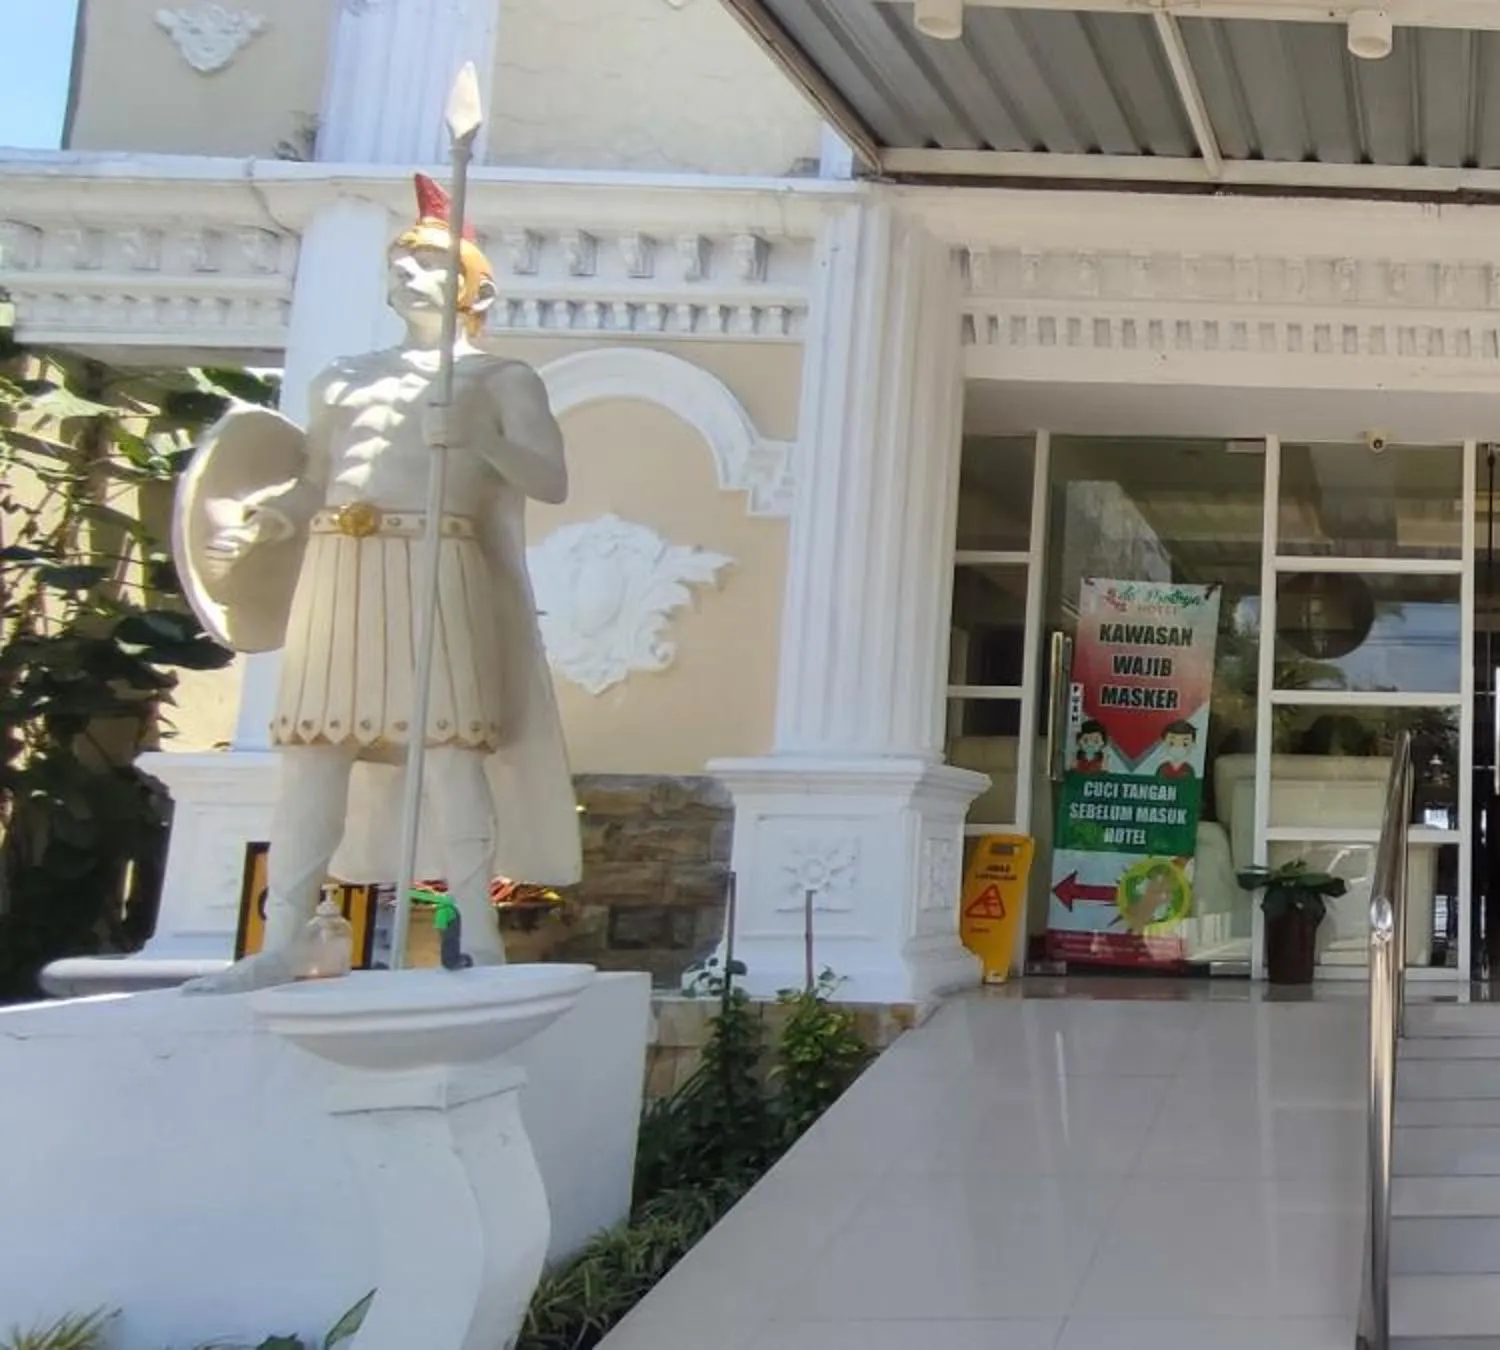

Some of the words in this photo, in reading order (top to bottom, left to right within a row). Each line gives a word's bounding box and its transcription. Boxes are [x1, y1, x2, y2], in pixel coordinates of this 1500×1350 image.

[1100, 624, 1193, 647] KAWASAN
[1113, 655, 1173, 677] WAJIB
[1101, 686, 1178, 709] MASKER
[1083, 781, 1119, 799] CUCI
[1122, 783, 1177, 801] TANGAN
[1069, 802, 1133, 822] SEBELUM
[1135, 806, 1188, 825] MASUK
[1103, 827, 1146, 845] HOTEL
